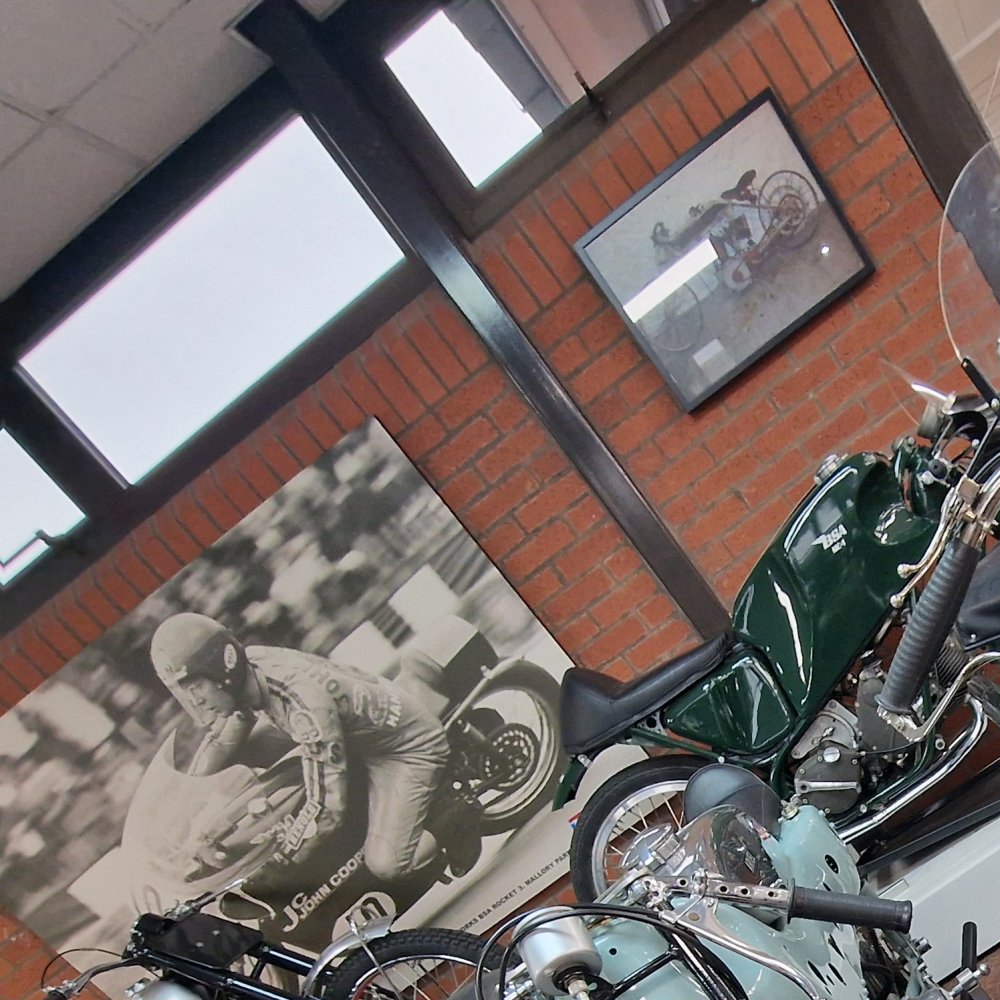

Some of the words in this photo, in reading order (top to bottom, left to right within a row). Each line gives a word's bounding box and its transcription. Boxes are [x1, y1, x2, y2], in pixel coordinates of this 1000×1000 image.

[816, 524, 848, 550] BSA
[299, 884, 331, 919] JOHN
[459, 917, 479, 932] ORKS
[478, 908, 492, 920] BSA
[493, 889, 519, 910] ROCKET
[525, 862, 555, 887] MALLORY
[555, 851, 571, 865] PAR
